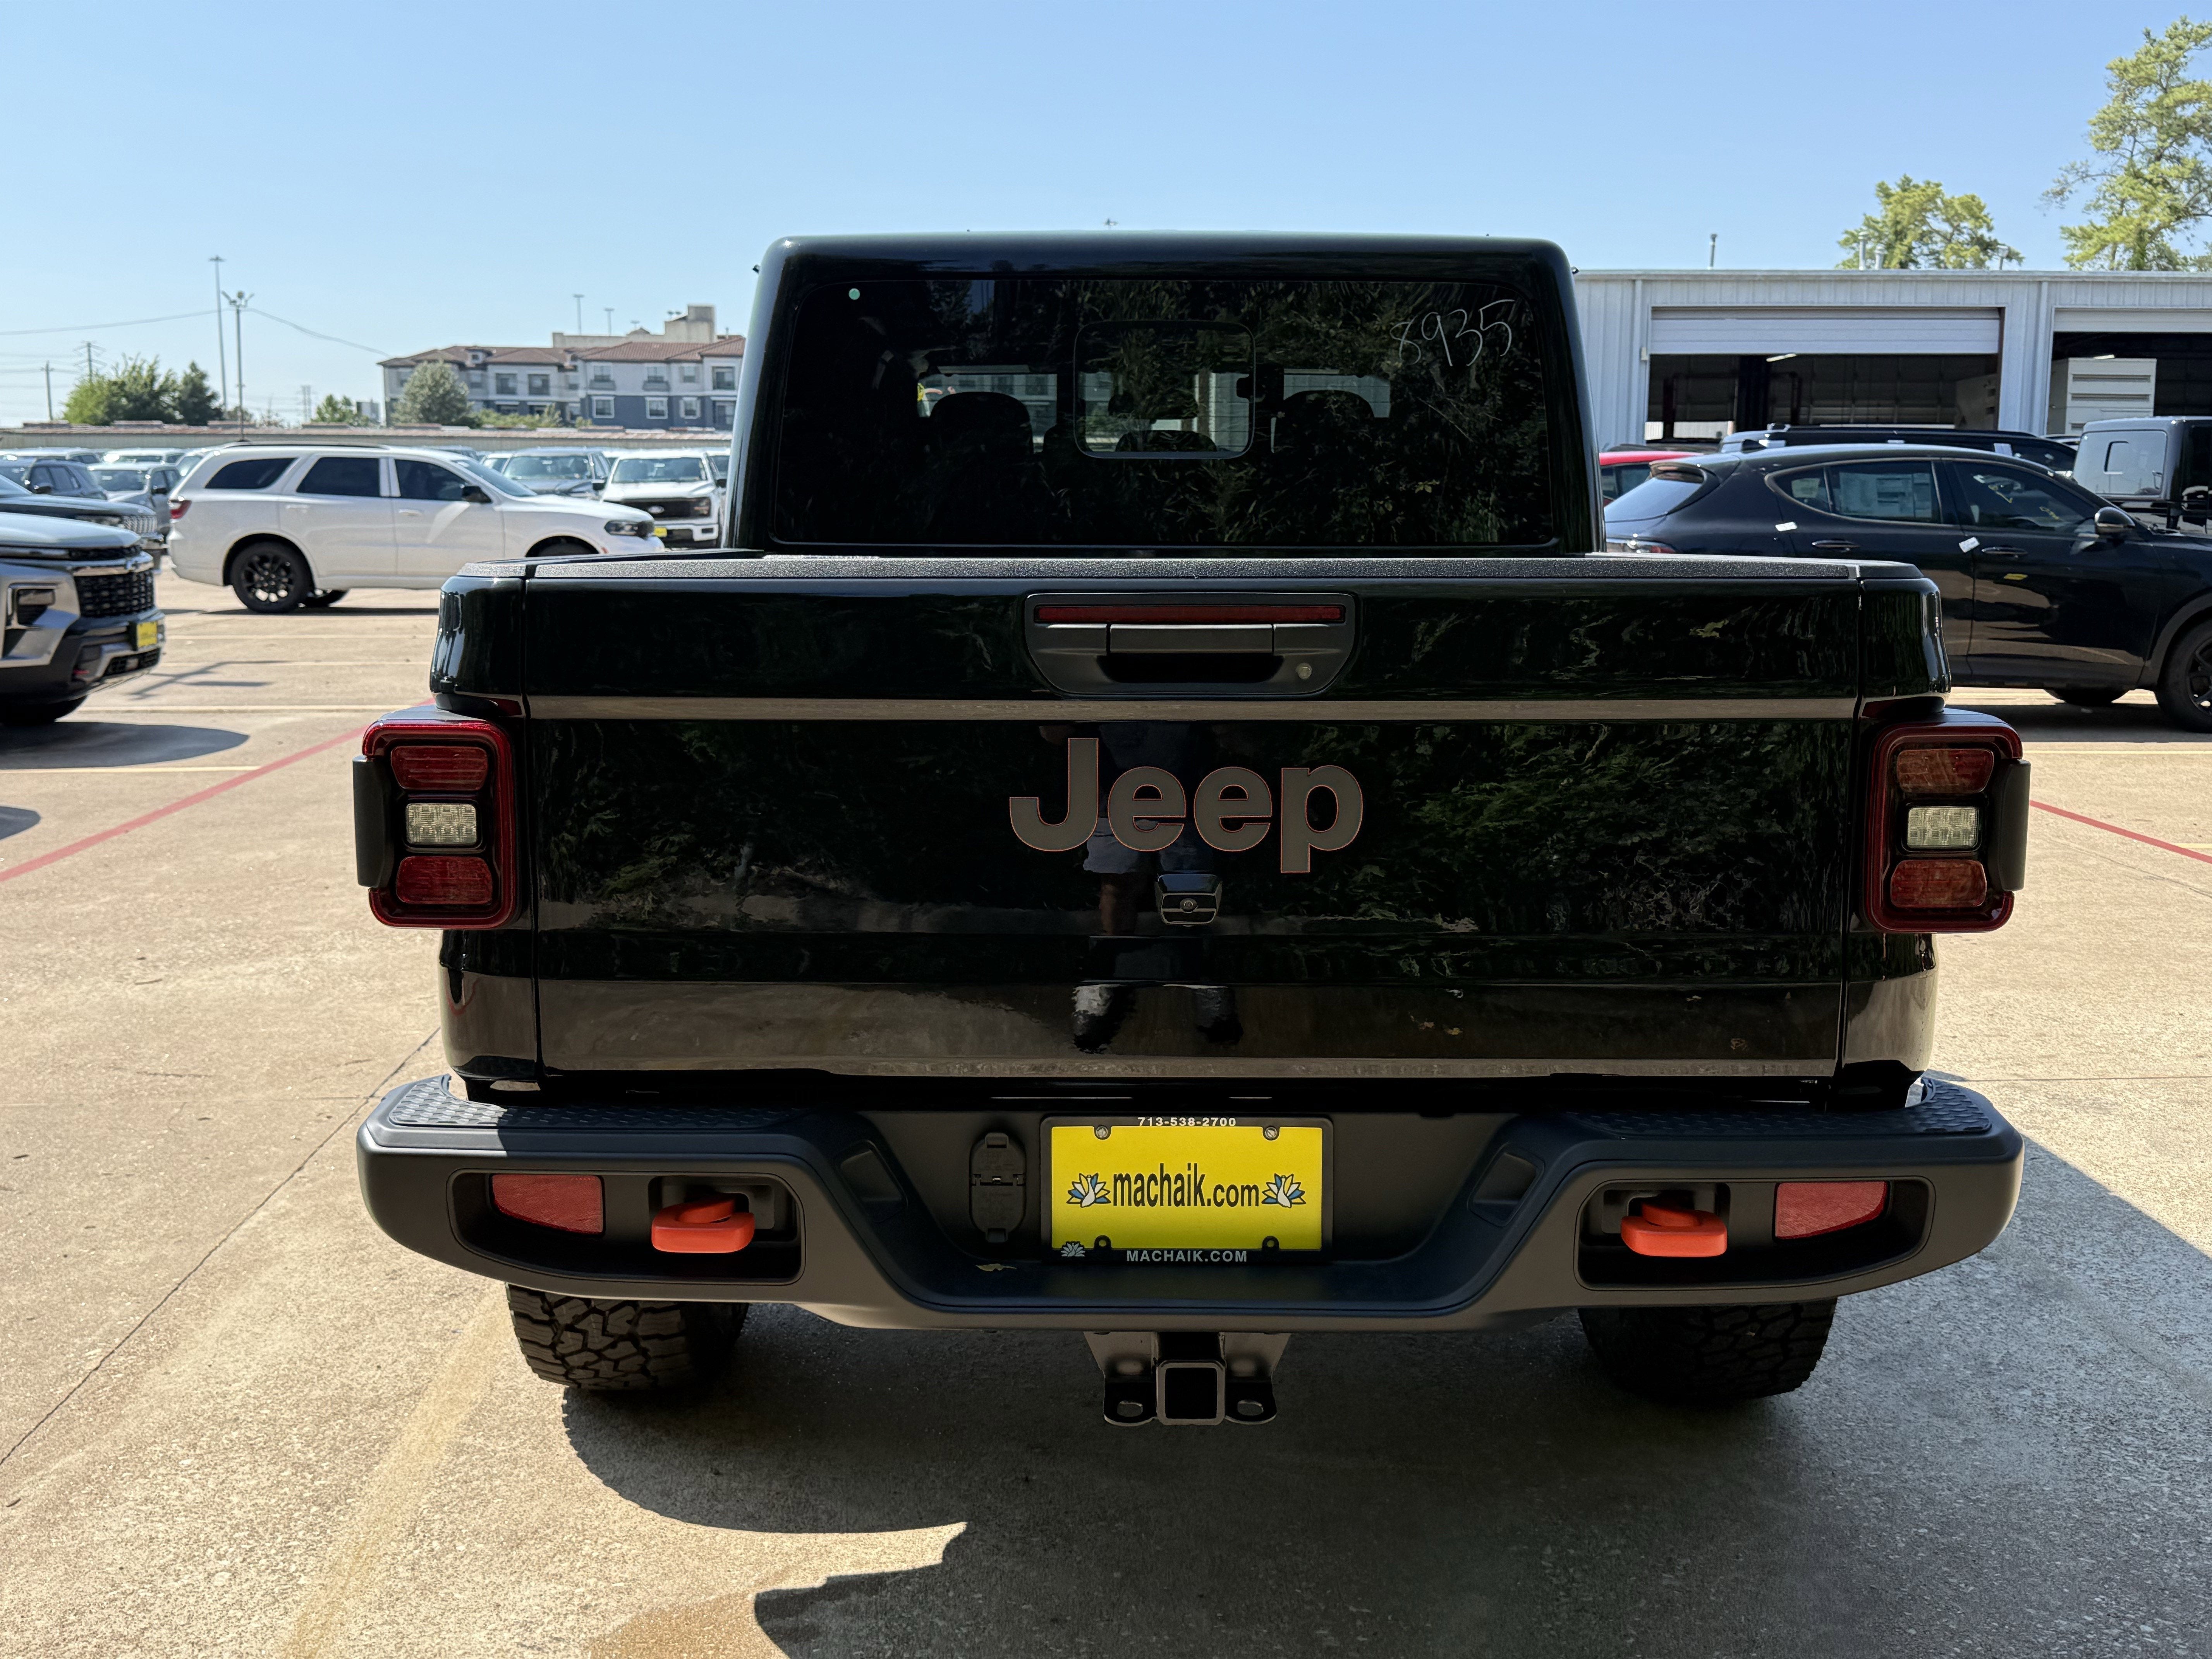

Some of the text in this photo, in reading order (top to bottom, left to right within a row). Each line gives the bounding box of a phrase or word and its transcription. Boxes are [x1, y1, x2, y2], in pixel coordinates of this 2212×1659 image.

[1389, 299, 1515, 366] 8935
[1009, 737, 1363, 873] Jeep
[1138, 1117, 1236, 1127] 713-538-2700
[1113, 1163, 1259, 1207] machaik.com
[1127, 1250, 1247, 1262] MACHAIK.COM
